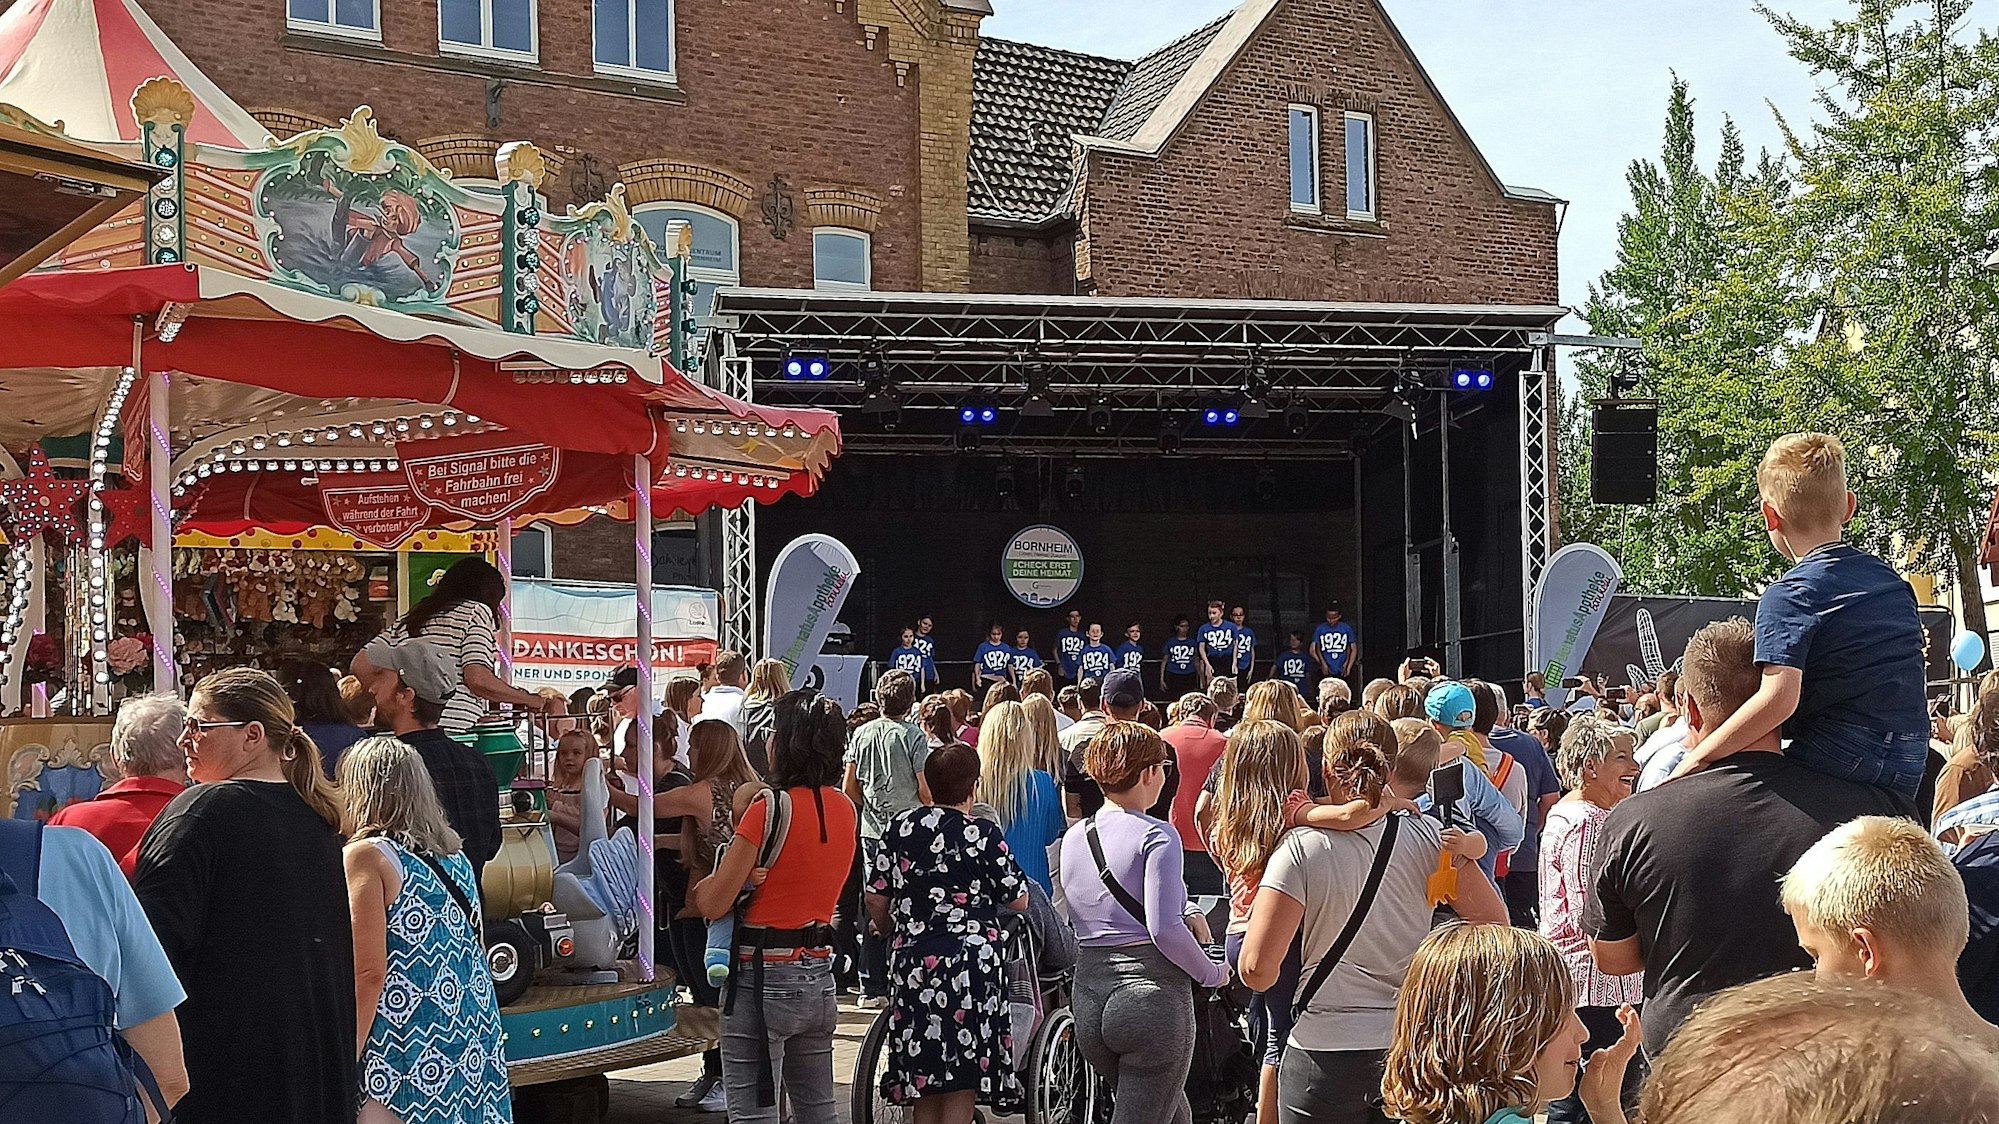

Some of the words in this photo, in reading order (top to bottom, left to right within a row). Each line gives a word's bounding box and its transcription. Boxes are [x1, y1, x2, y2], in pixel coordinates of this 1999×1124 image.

[428, 463, 447, 477] Bei
[450, 458, 487, 476] Signal
[490, 456, 516, 469] bitte
[519, 452, 537, 466] die
[445, 475, 501, 492] Fahrbahn
[504, 471, 523, 485] frei
[358, 493, 399, 505] Aufstehen
[461, 489, 511, 508] machen!
[342, 508, 379, 520] während
[380, 507, 394, 518] der
[396, 506, 418, 517] Fahrt
[363, 520, 402, 534] verboten!
[1014, 540, 1073, 553] BORNHEIM
[1012, 569, 1039, 577] DEINE
[1040, 569, 1073, 577] HEIMAT
[1050, 561, 1072, 569] ERST
[1320, 632, 1348, 651] 1924
[984, 650, 1010, 669] 1924
[1083, 651, 1109, 669] 1924
[1123, 651, 1143, 668] 192
[1284, 659, 1305, 676] 192
[544, 669, 572, 679] UND
